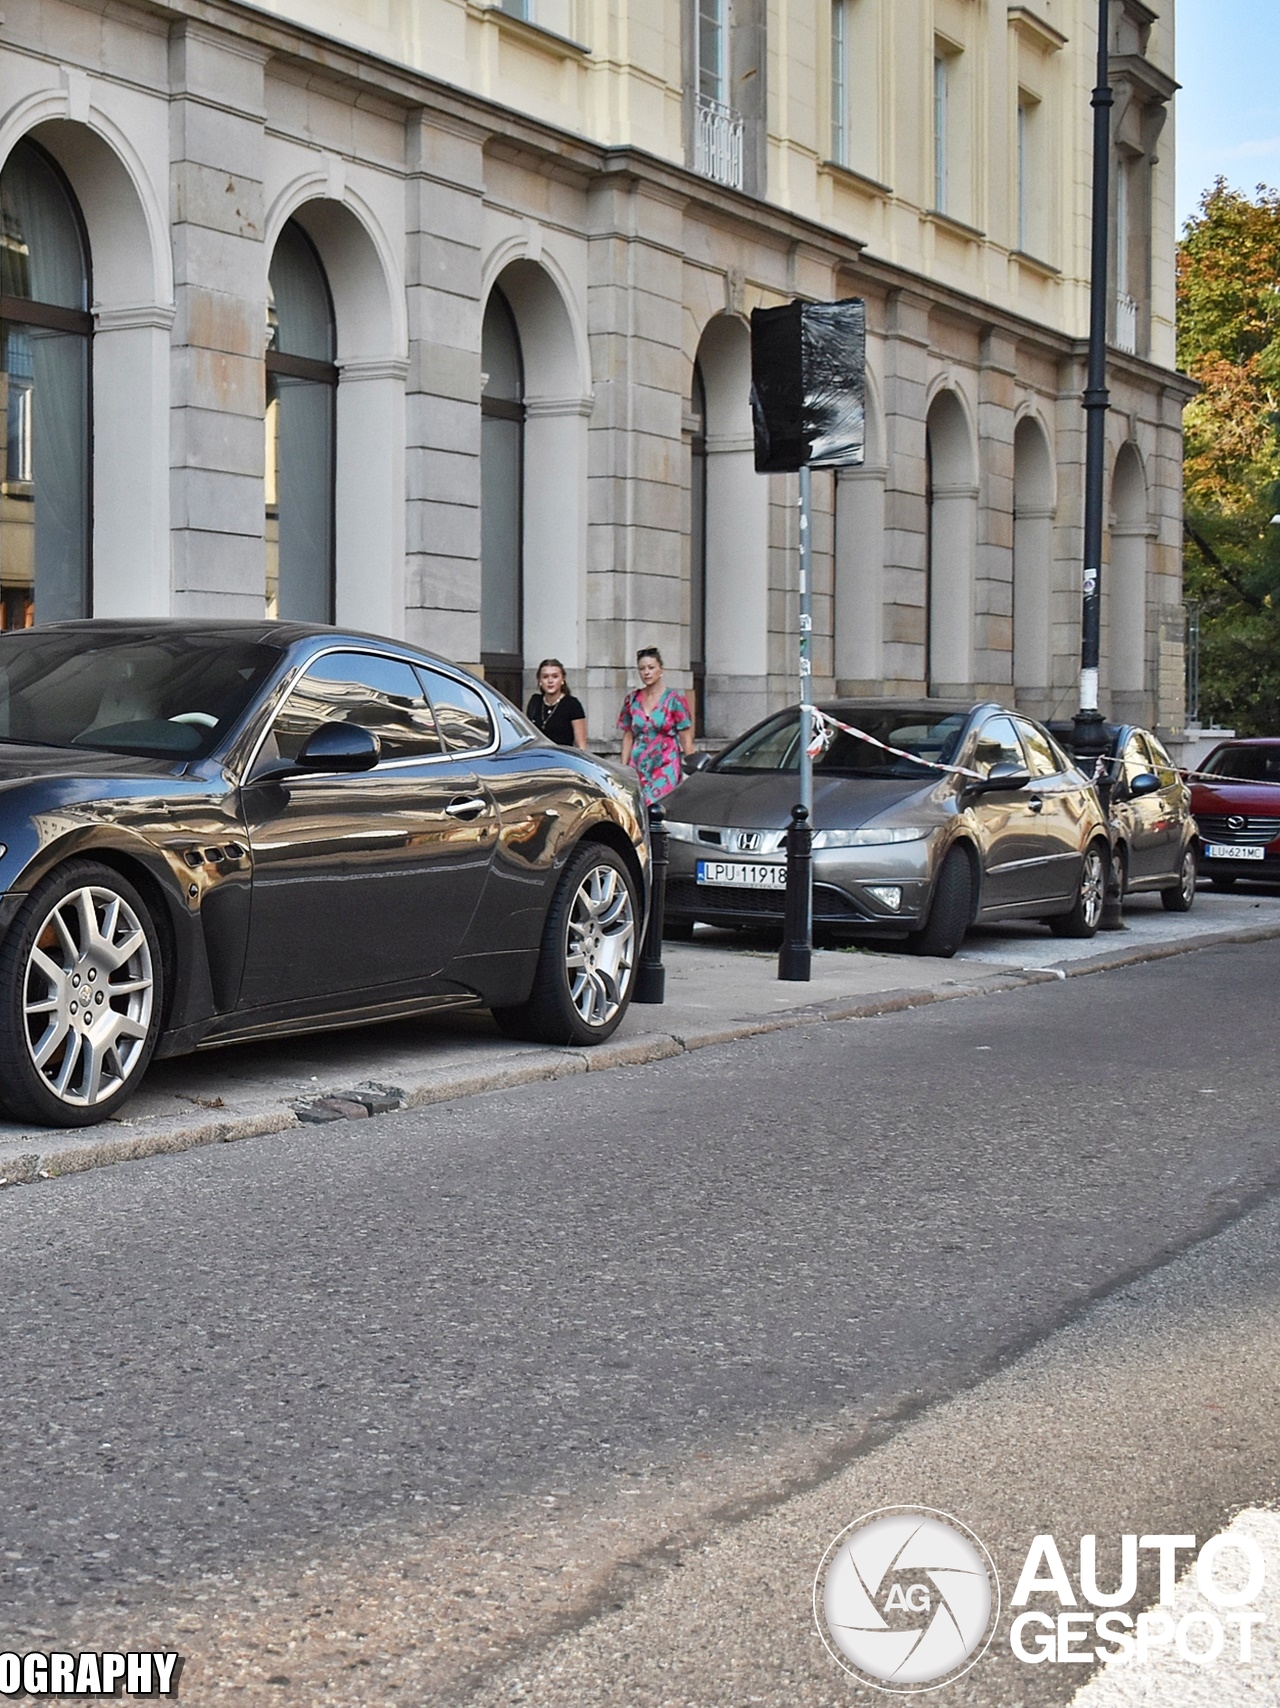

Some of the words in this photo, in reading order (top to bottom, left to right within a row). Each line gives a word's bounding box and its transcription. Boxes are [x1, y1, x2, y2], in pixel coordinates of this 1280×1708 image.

[1212, 846, 1225, 857] LU
[706, 864, 735, 881] LPU
[741, 866, 787, 884] 11918
